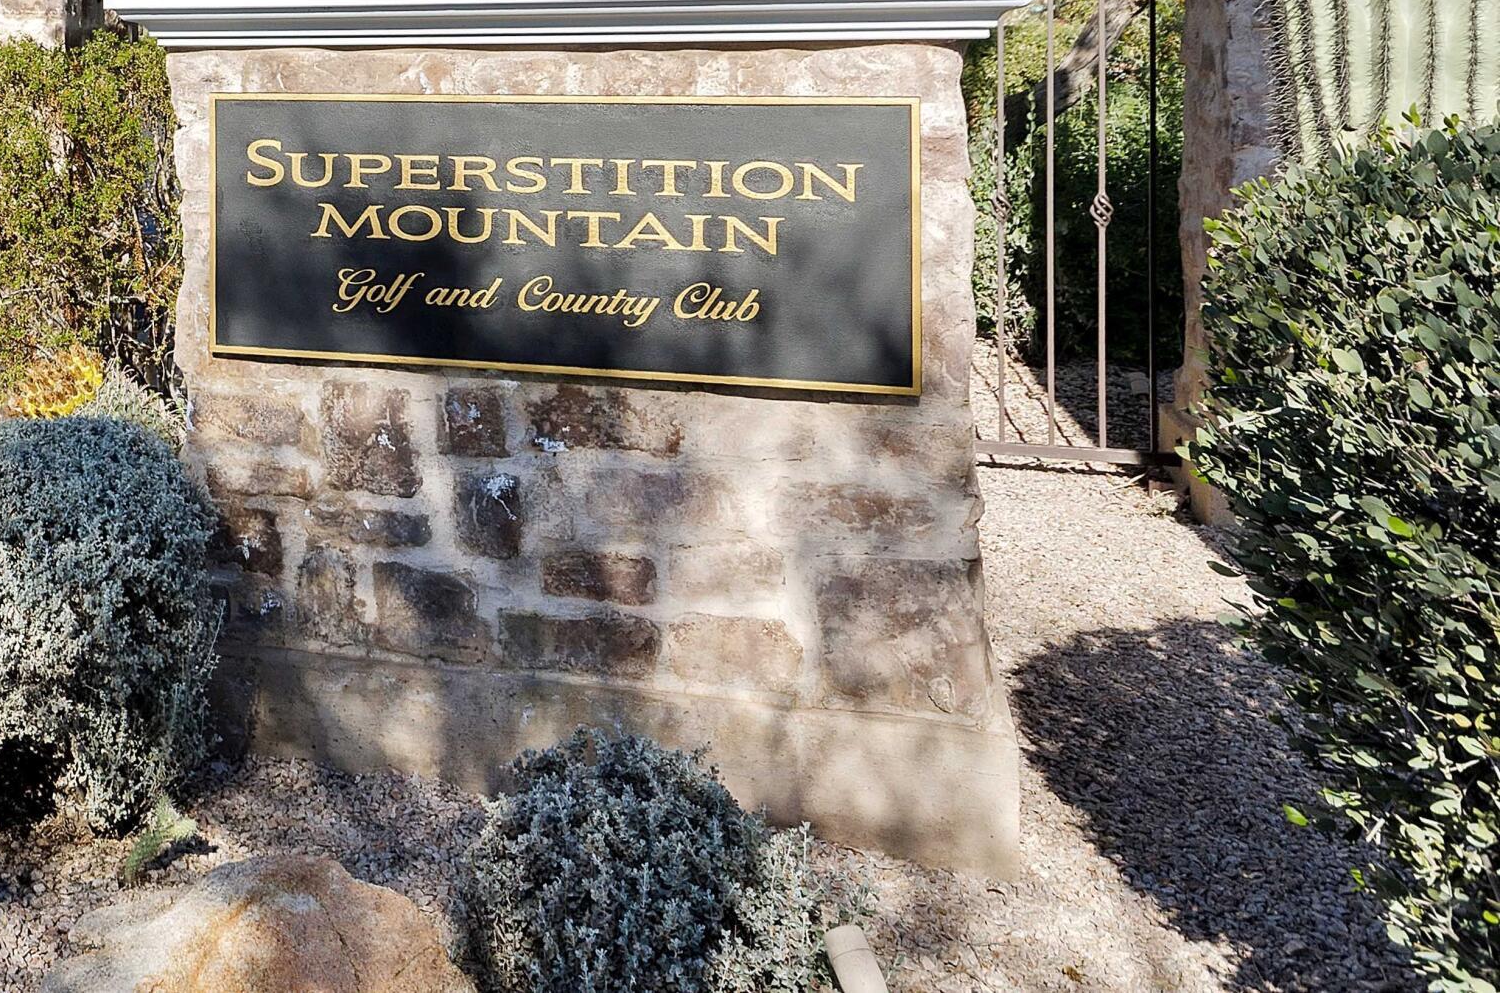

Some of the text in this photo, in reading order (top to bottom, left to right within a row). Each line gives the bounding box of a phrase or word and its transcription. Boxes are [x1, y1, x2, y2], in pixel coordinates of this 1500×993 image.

[245, 138, 865, 204] SUPERSTITION
[309, 203, 786, 256] MOUNTAIN
[331, 267, 761, 327] Golf and Country Club
